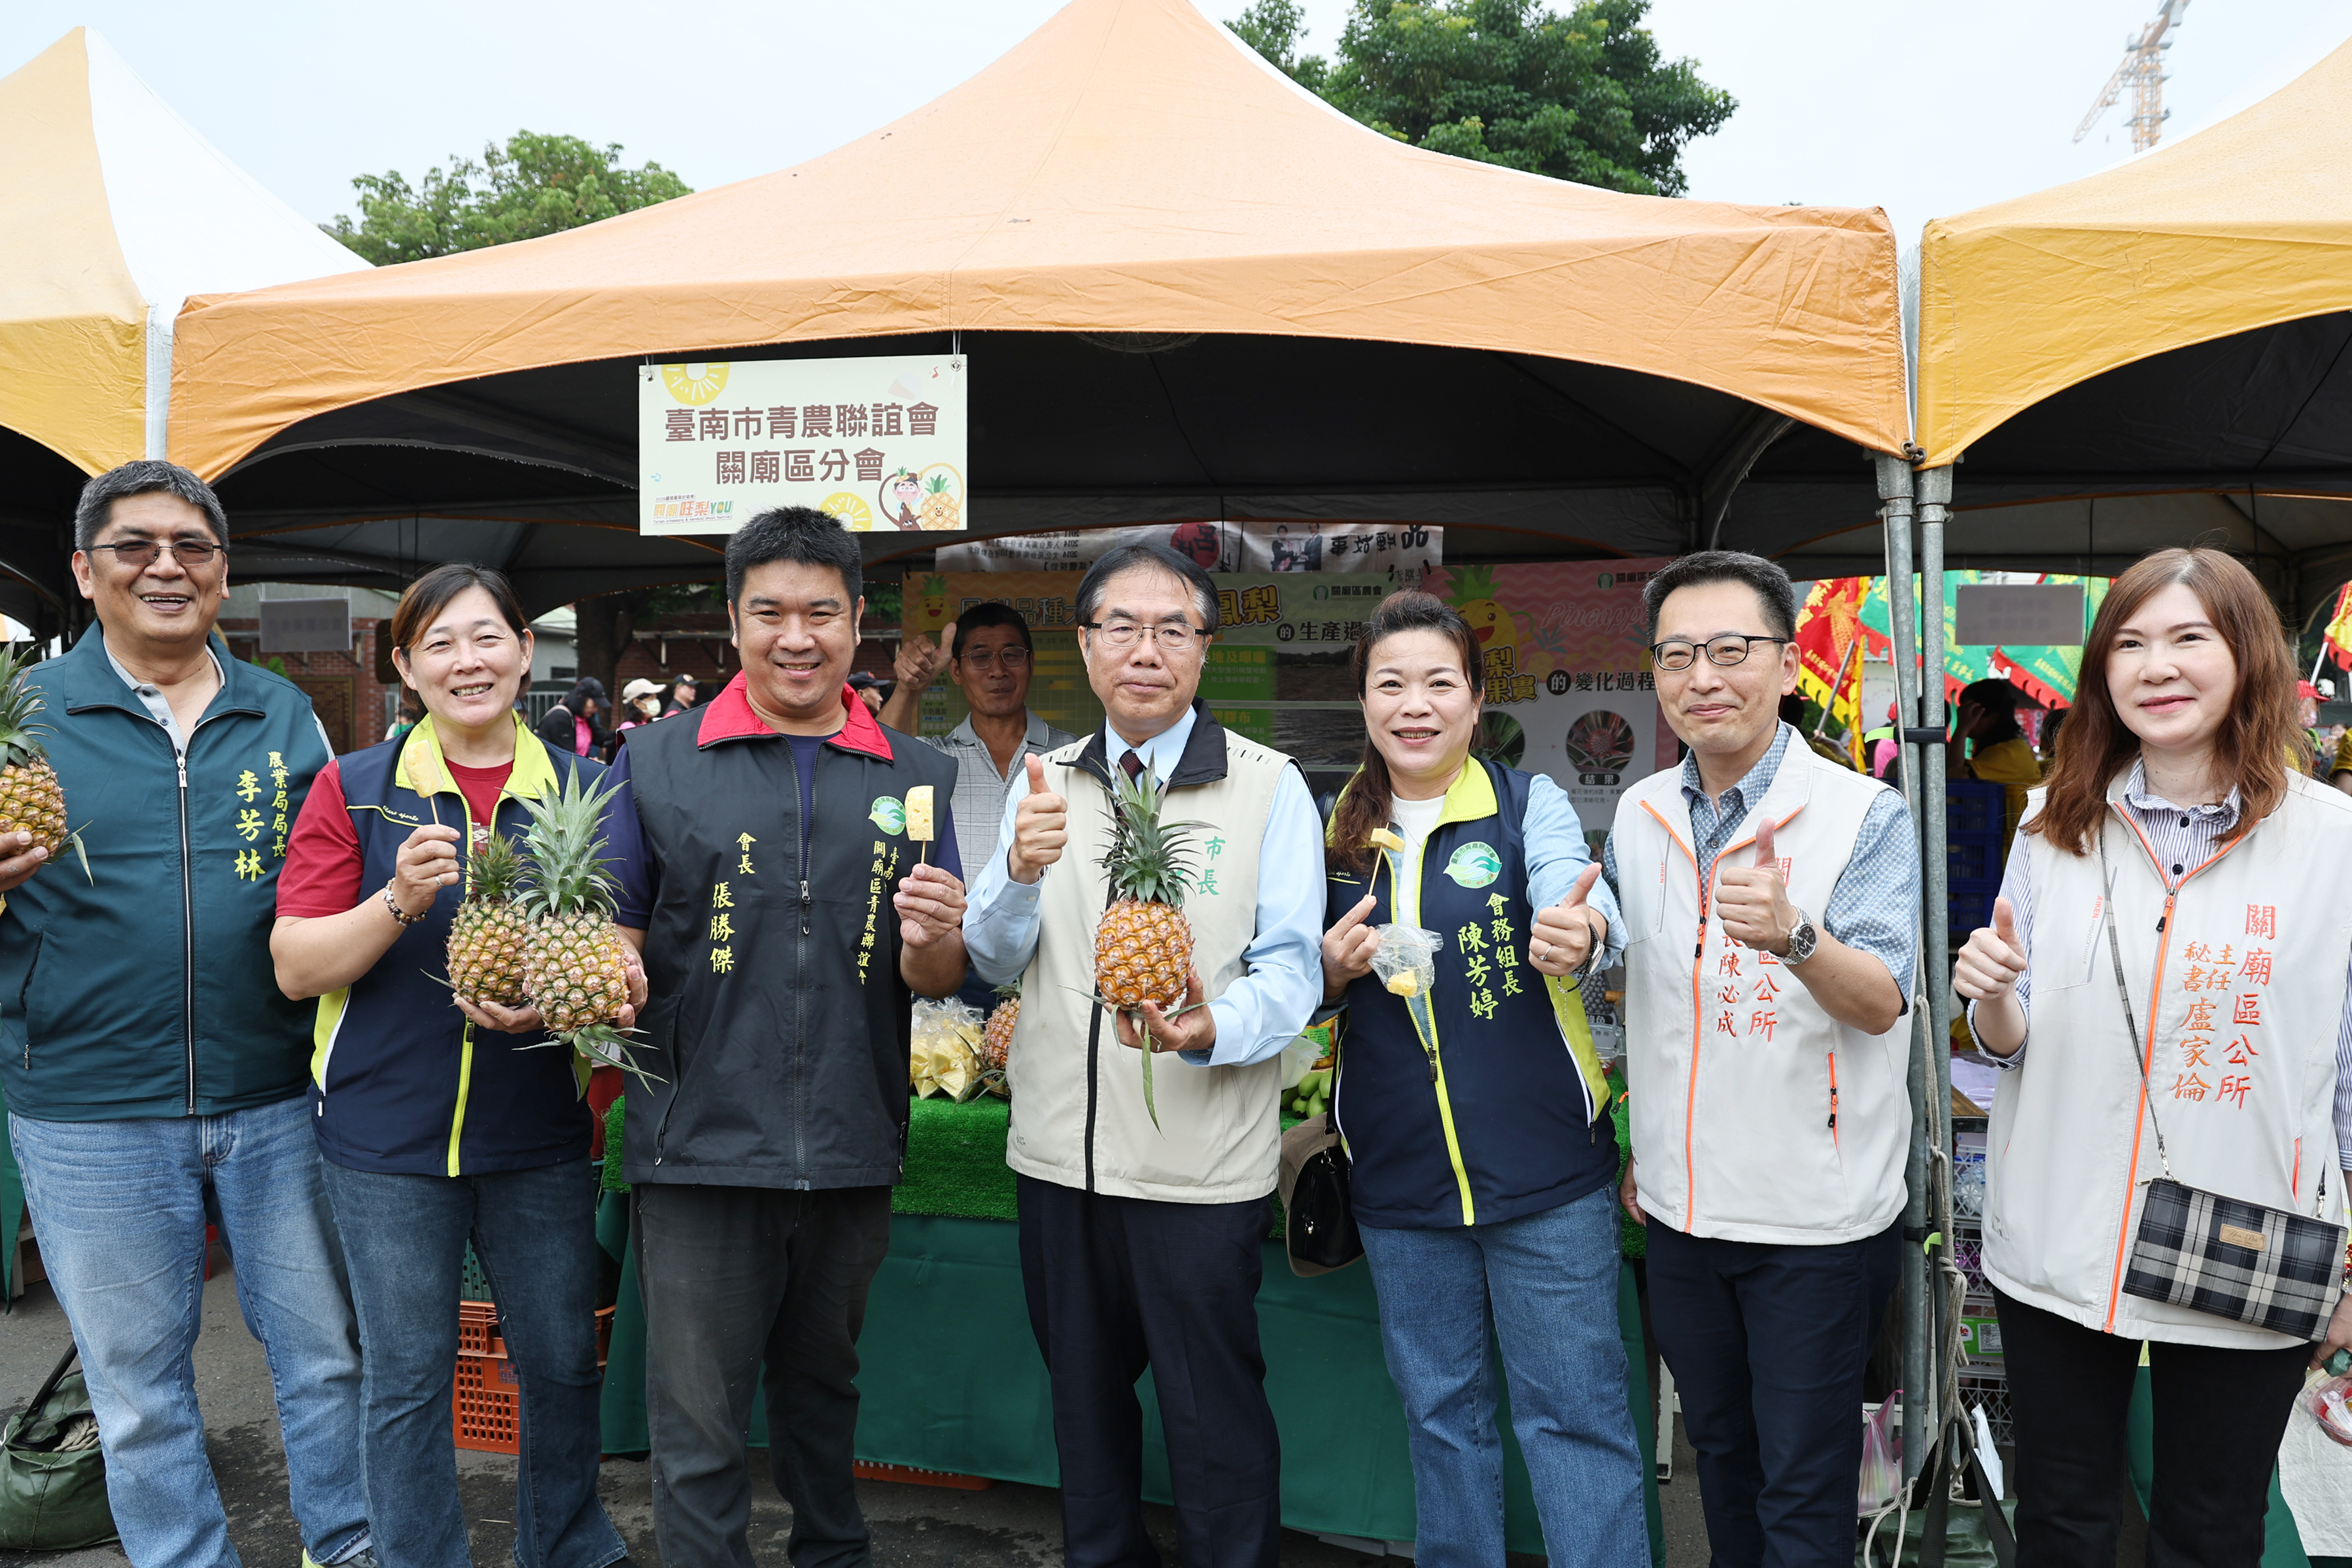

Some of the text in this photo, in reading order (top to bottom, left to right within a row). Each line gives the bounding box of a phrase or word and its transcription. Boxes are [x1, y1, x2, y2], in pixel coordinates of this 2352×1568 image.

[665, 401, 939, 442] 臺南市青農聯誼會
[715, 447, 886, 485] 關廟區分會
[233, 769, 266, 882] 李芳林
[268, 751, 290, 857] 農業局局長
[736, 832, 757, 874] 會長
[1197, 836, 1226, 895] 市長
[709, 881, 735, 974] 張勝傑
[1485, 892, 1523, 997] 會務組長
[2086, 895, 2103, 948] AIKEN FASHION
[1457, 921, 1498, 1020] 陳芳婷
[2215, 903, 2276, 1110] 關廟區公所
[2169, 997, 2217, 1102] 盧家倫
